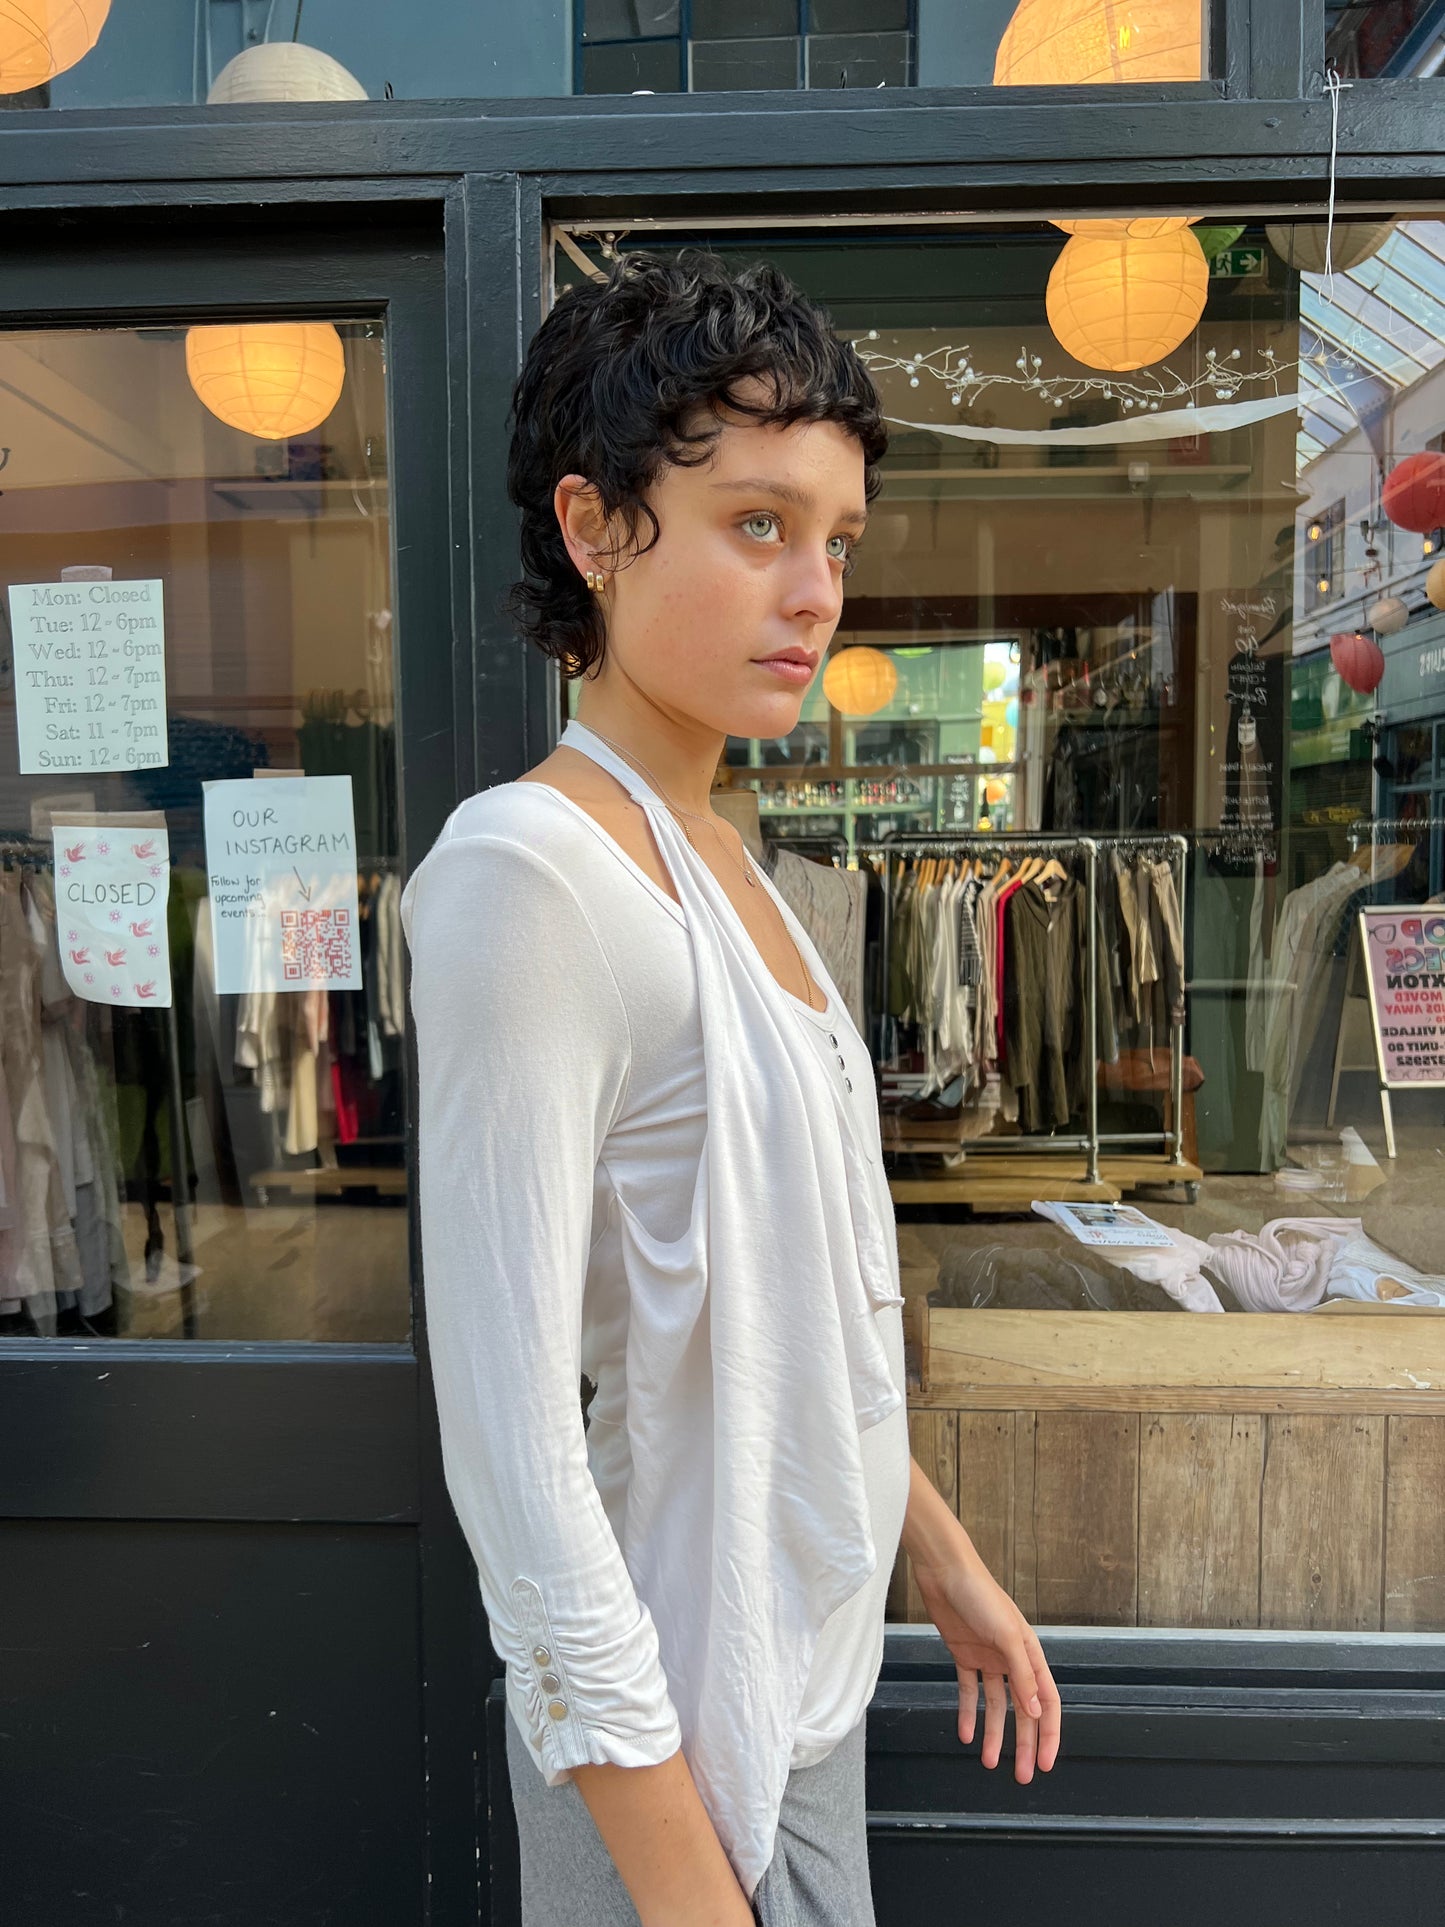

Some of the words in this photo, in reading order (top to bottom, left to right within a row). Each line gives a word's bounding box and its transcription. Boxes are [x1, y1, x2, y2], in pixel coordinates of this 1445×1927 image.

[32, 588, 82, 606] Mon:
[88, 584, 151, 604] Closed
[30, 616, 74, 633] Tue:
[28, 642, 82, 660] Wed:
[26, 670, 74, 688] Thu:
[44, 697, 77, 714] Fri:
[46, 724, 80, 740] Sat:
[38, 750, 82, 767] Sun:
[233, 808, 278, 827] OUR
[226, 832, 350, 856] INSTAGRAM
[211, 875, 240, 887] Follow
[244, 874, 261, 894] for
[68, 882, 156, 906] CLOSED
[215, 893, 266, 910] upcoming
